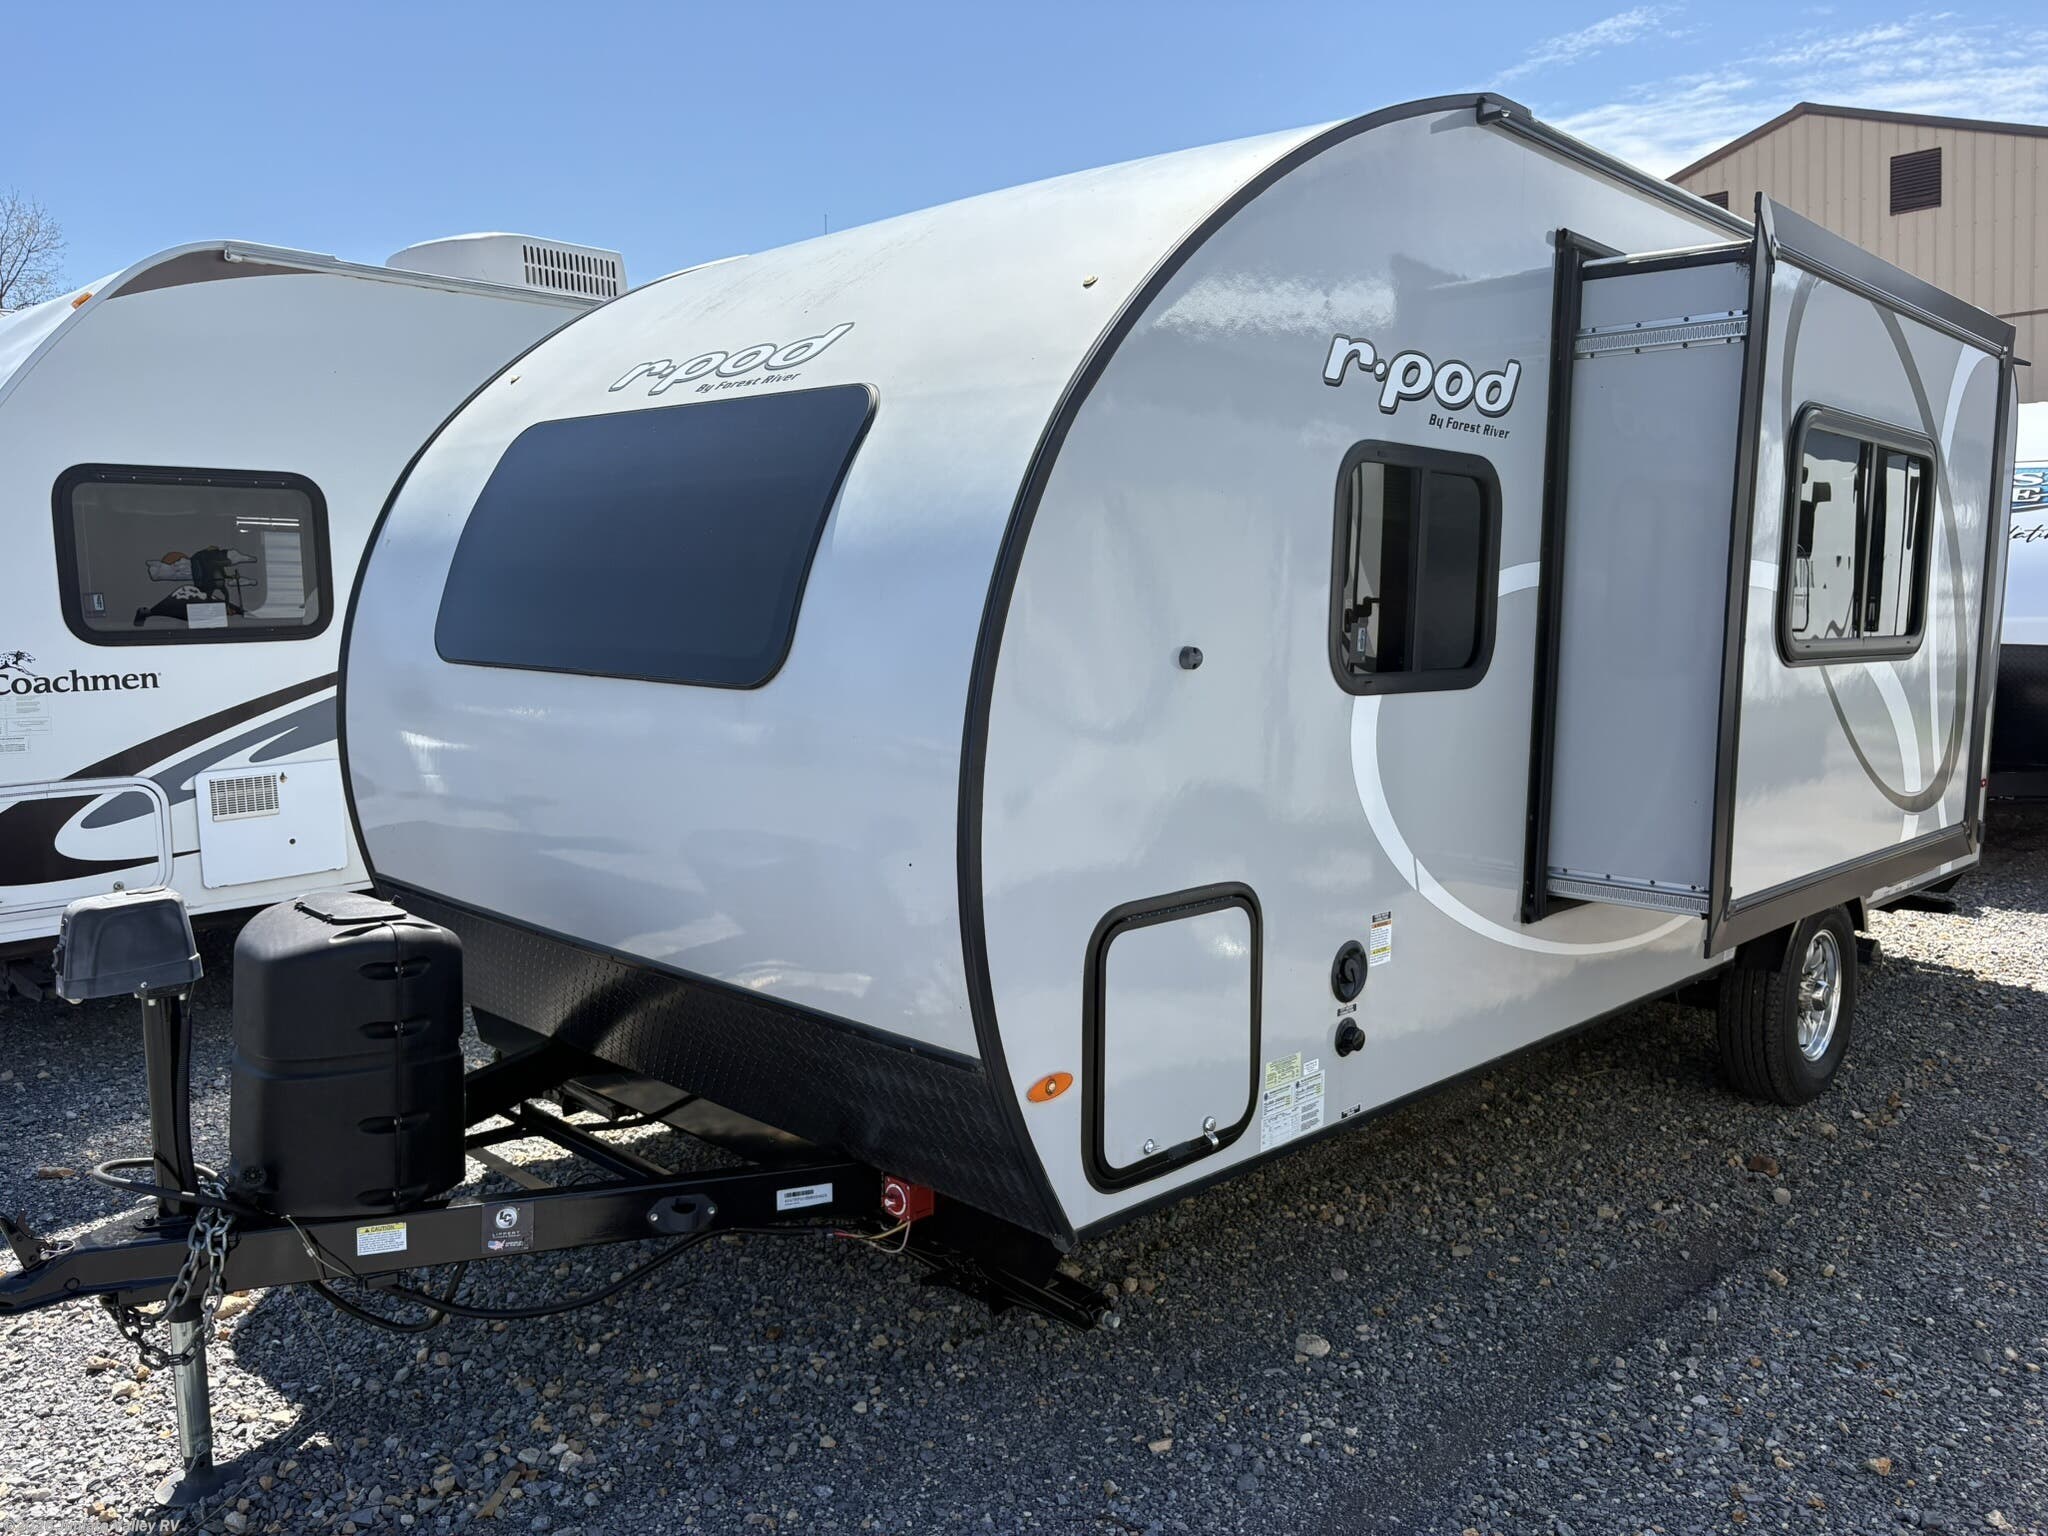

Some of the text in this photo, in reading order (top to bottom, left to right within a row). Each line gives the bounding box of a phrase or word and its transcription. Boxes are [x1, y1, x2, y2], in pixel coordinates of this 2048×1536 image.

[695, 373, 801, 393] By Forest River
[1428, 413, 1510, 439] By Forest River
[371, 1224, 395, 1232] CAUTION
